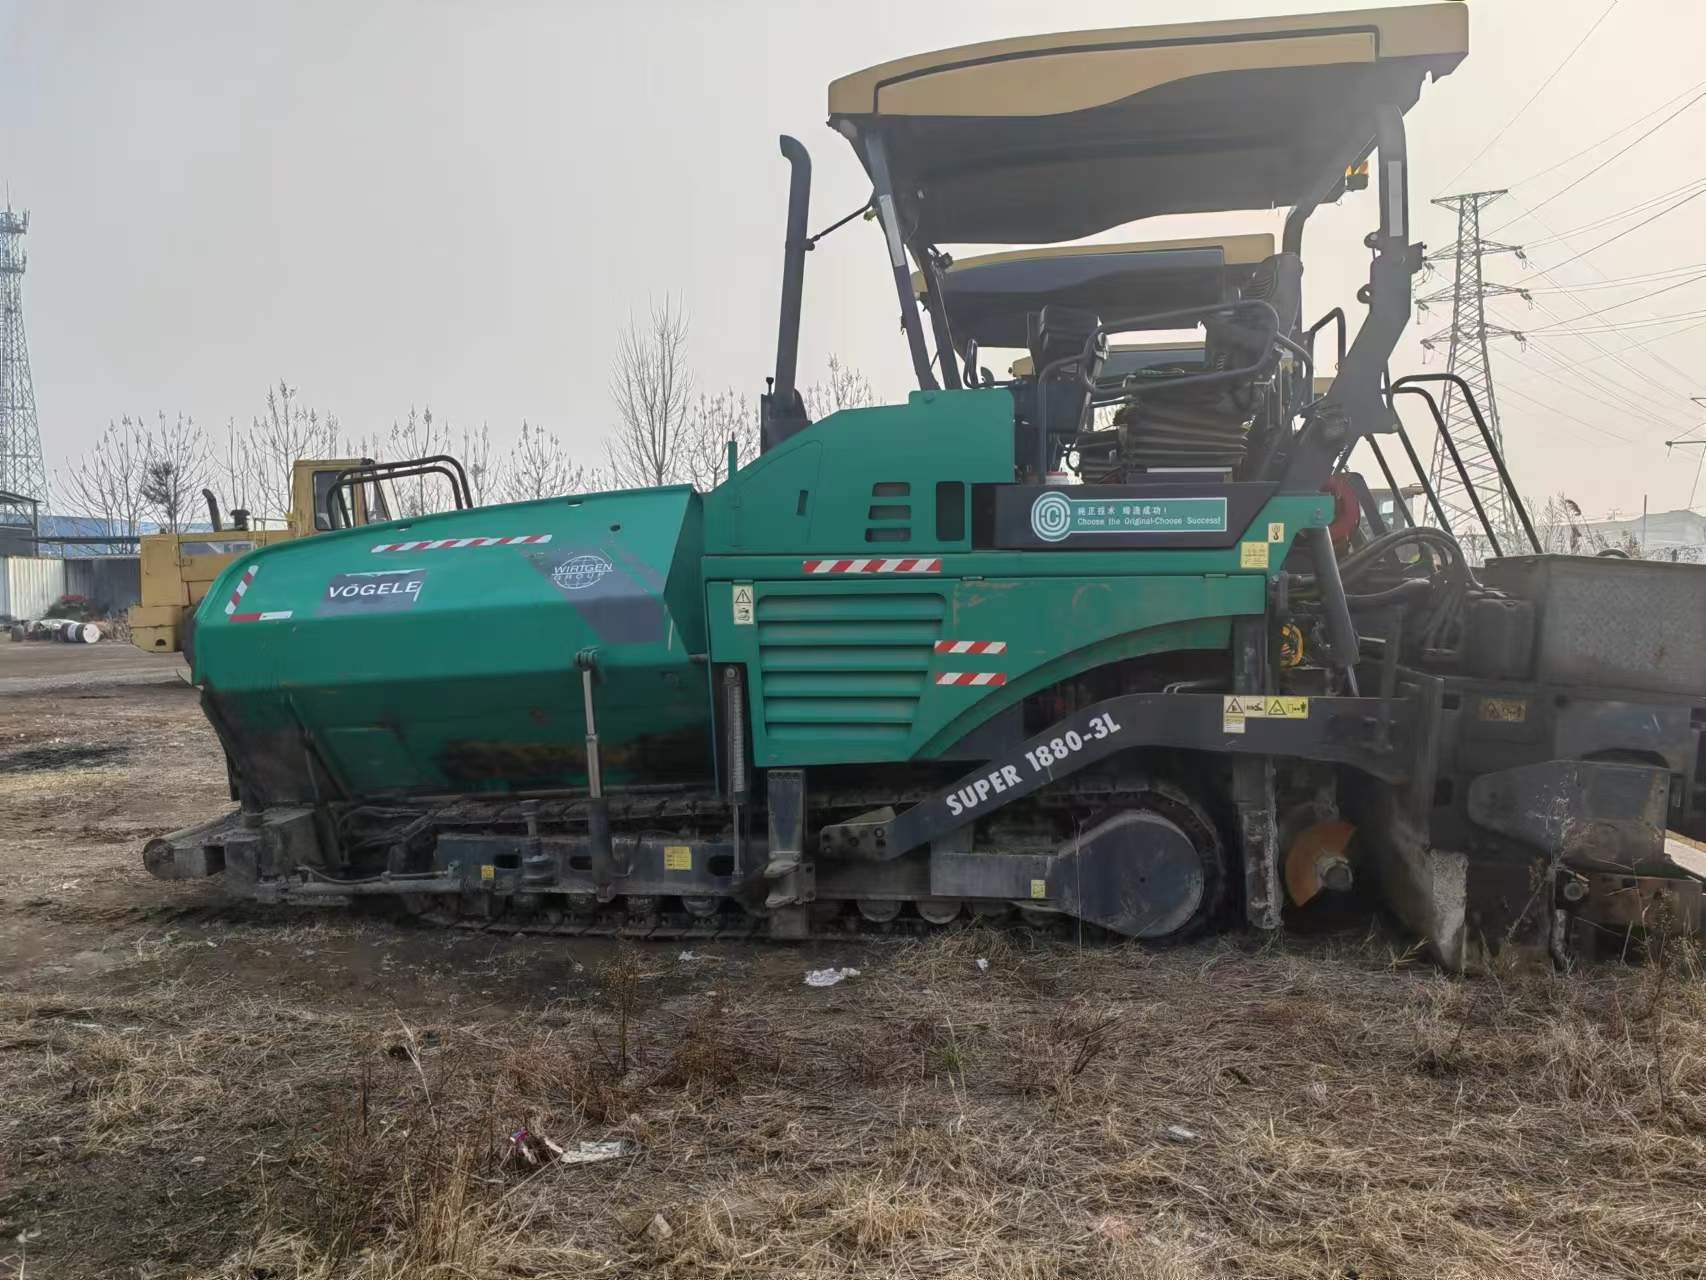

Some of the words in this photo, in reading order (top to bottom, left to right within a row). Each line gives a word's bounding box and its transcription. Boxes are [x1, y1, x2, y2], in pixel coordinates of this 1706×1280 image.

[1077, 518, 1104, 526] Choose
[1108, 517, 1120, 526] the
[1187, 516, 1221, 525] Success!
[554, 563, 613, 573] WIRTGEN
[329, 581, 422, 598] VÖGELE
[946, 764, 1024, 816] SUPER
[1025, 712, 1122, 772] 1880-3L
